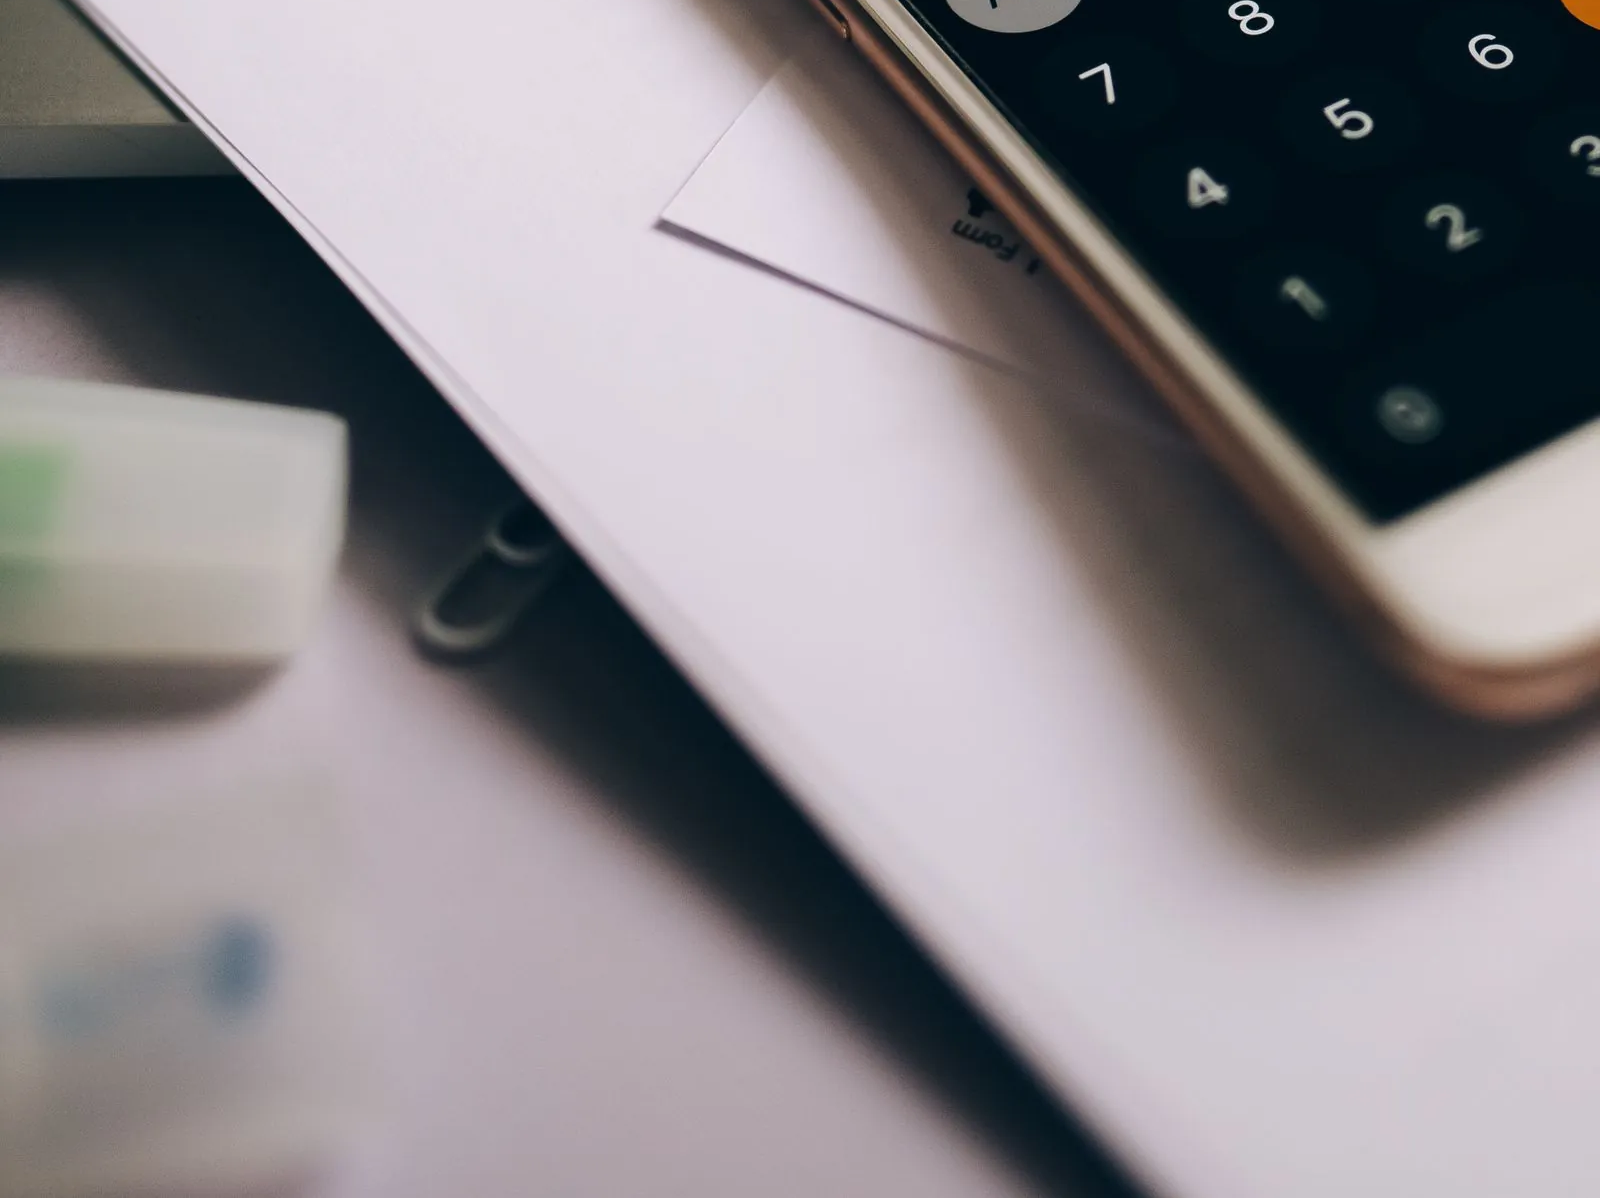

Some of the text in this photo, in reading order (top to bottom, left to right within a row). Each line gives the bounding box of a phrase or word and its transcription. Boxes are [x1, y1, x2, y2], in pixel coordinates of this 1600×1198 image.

[1078, 62, 1116, 105] 7
[1227, 0, 1275, 36] 8
[1186, 33, 1514, 208] 4 5 6
[1425, 204, 1481, 252] 2
